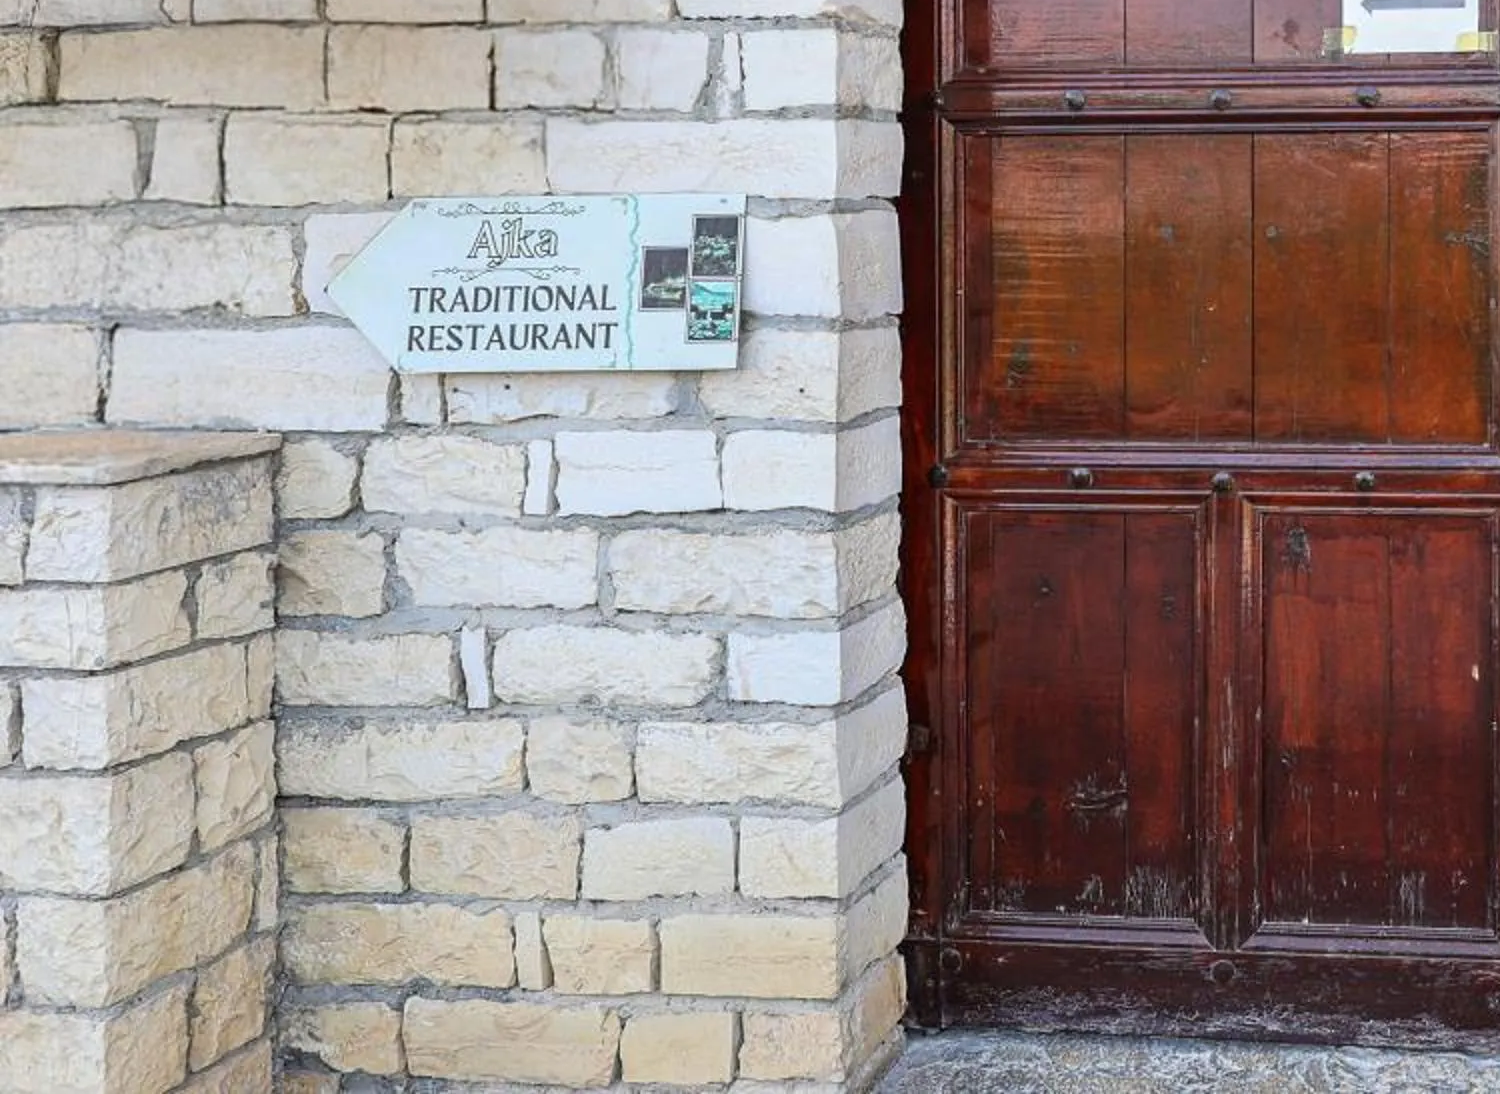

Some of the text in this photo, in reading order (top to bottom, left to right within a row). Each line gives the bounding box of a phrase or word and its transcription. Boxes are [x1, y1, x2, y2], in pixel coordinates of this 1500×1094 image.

[466, 217, 559, 267] Ajka
[408, 284, 617, 314] TRADITIONAL
[406, 322, 618, 352] RESTAURANT
